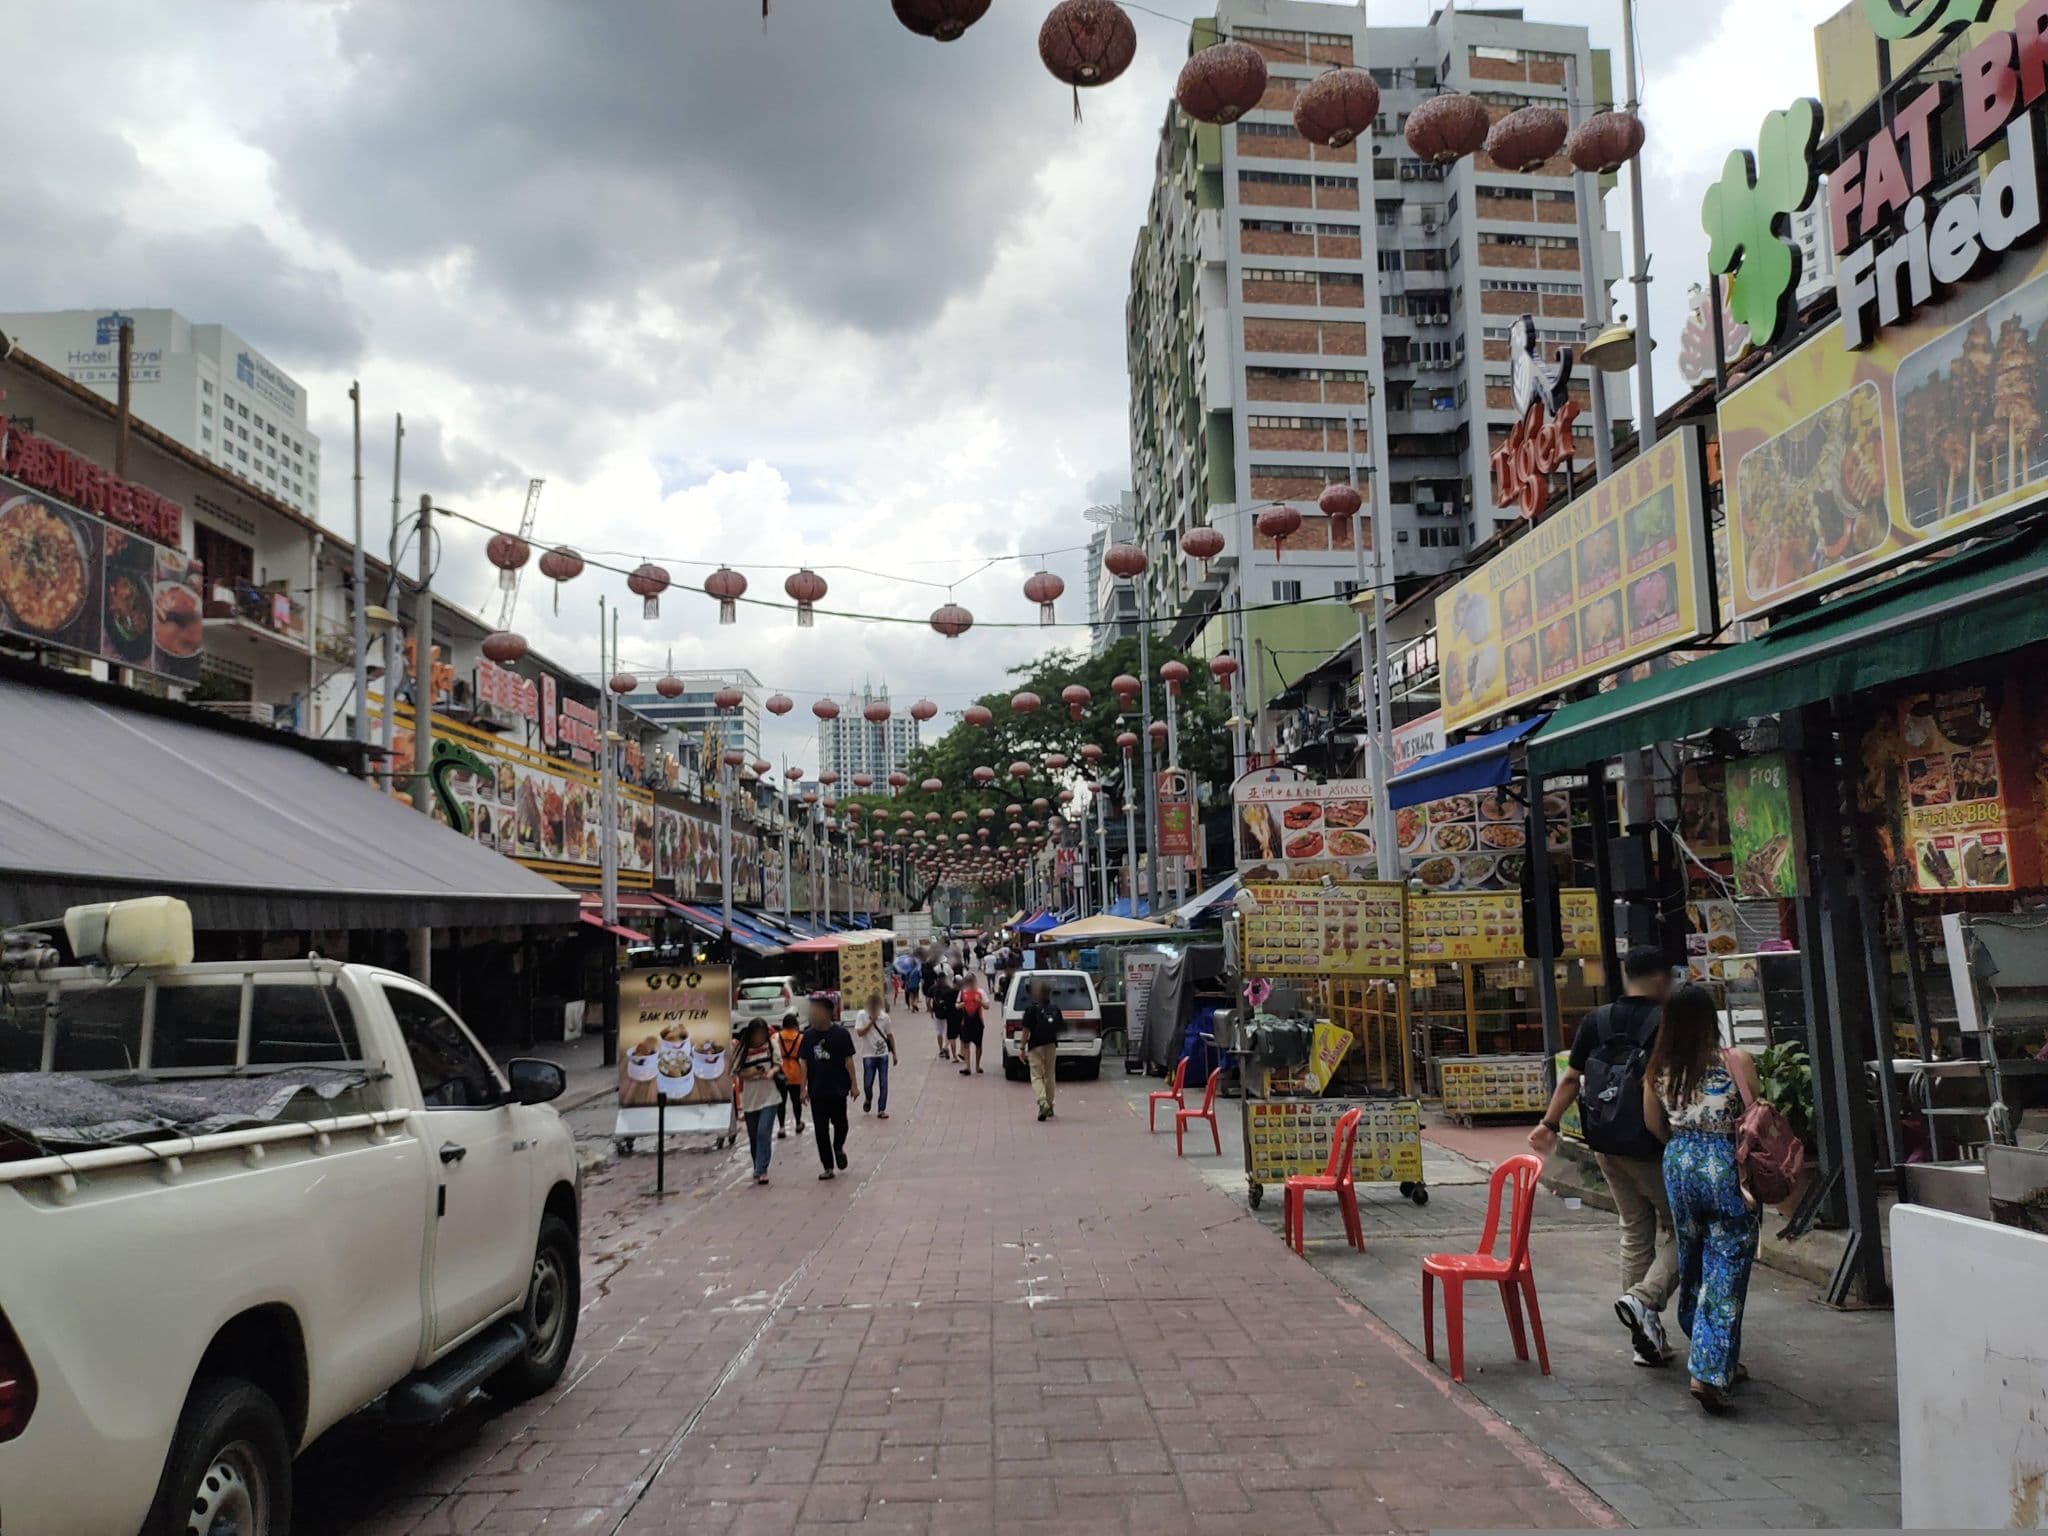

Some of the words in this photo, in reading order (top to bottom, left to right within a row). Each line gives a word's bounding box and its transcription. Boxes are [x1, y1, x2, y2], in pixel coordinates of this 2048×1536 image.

[1828, 81, 1942, 256] FAT
[1838, 110, 2041, 352] Fried
[68, 350, 112, 364] Hotel
[118, 349, 162, 365] oyal
[68, 370, 161, 380] SIGNAURE
[1159, 775, 1188, 795] 4D
[1913, 809, 1948, 828] Fried
[1951, 807, 1962, 824] &
[1967, 802, 2001, 823] BBQ
[639, 1010, 661, 1023] BAK
[664, 1009, 686, 1021] KUT
[688, 1009, 709, 1021] TEH
